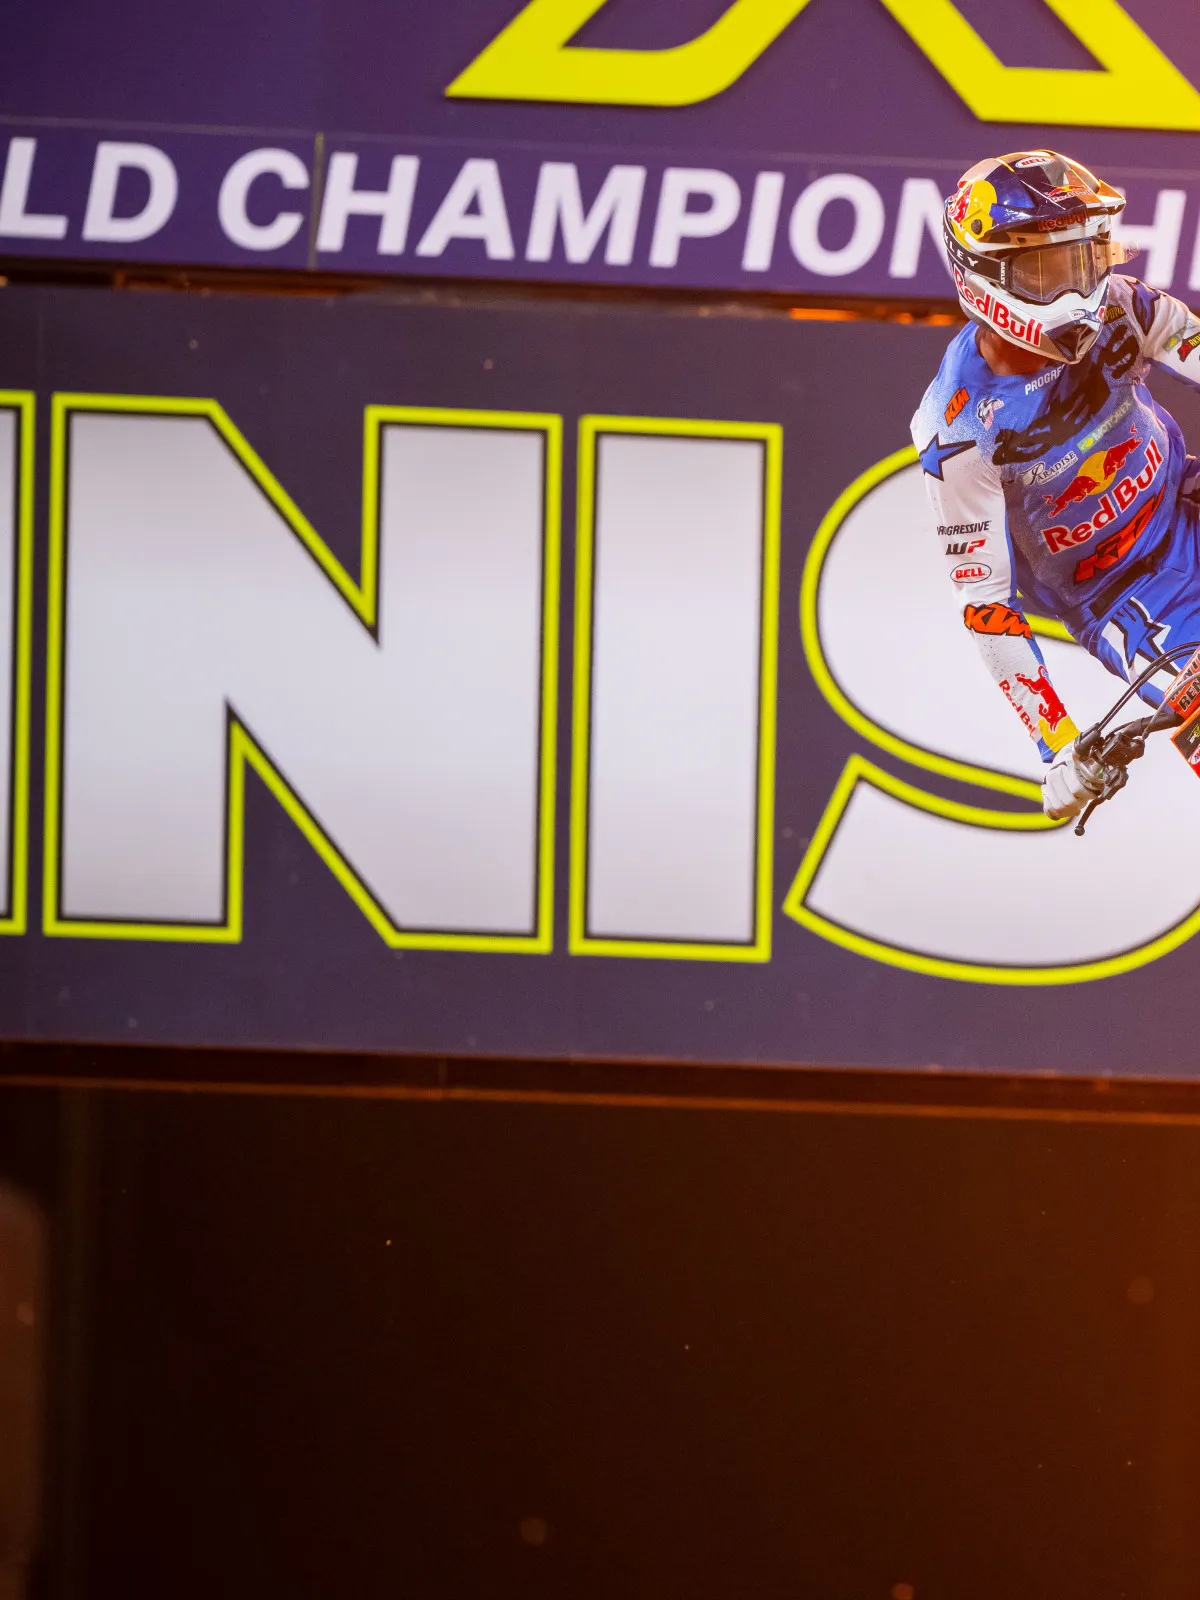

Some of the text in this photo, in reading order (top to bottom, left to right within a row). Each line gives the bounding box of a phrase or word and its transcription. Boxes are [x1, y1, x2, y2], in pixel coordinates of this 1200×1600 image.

[1092, 399, 1131, 440] MOTOREX
[1042, 493, 1116, 555] Red
[1110, 436, 1164, 513] Bull
[936, 520, 990, 536] RGRESSIVE
[955, 567, 985, 579] BELL
[964, 602, 1034, 639] KTM
